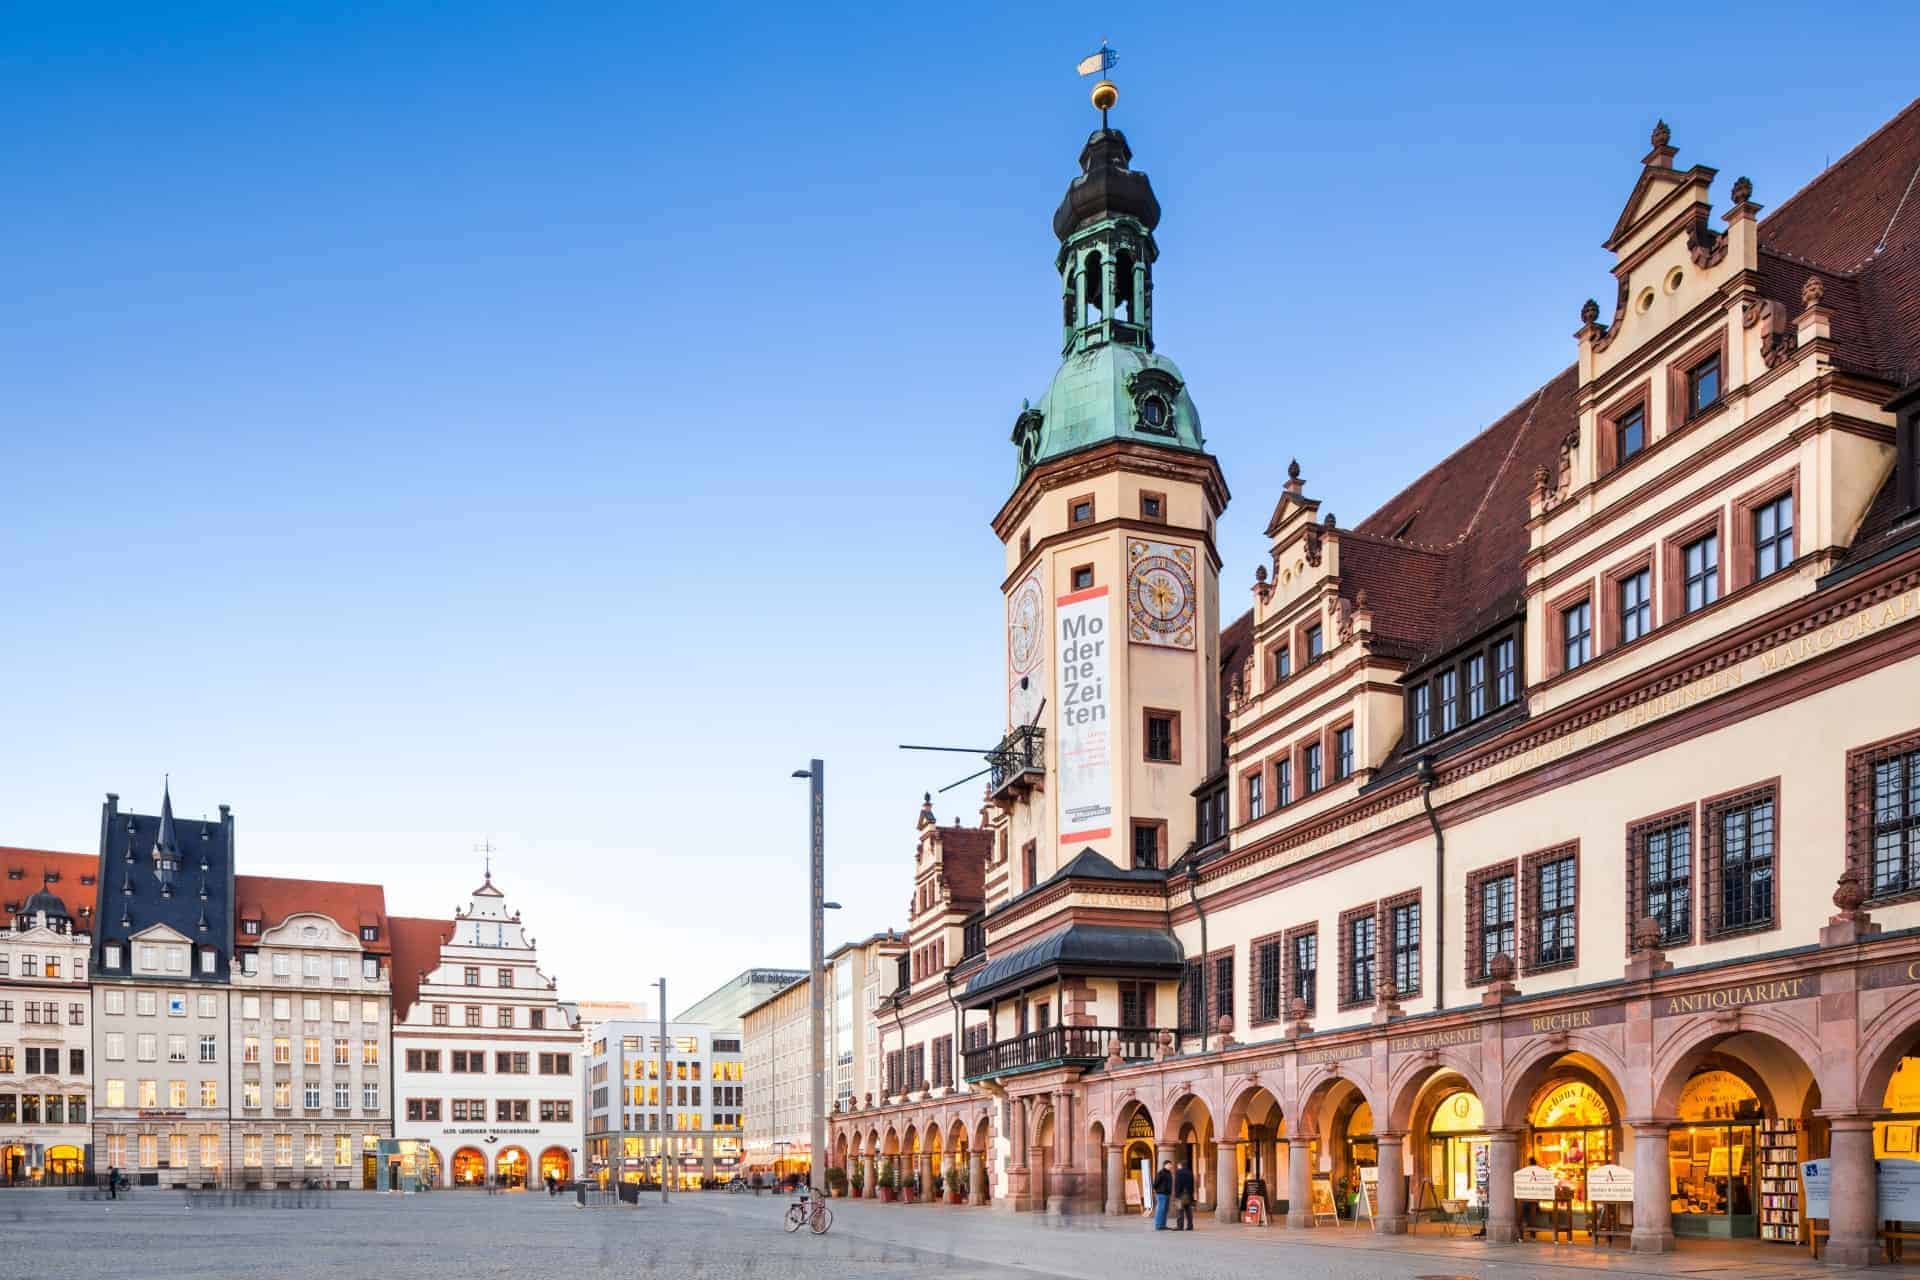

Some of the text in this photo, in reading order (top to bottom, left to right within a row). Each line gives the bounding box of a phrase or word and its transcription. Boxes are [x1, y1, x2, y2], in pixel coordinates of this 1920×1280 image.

[1062, 614, 1104, 641] Mo
[1063, 640, 1105, 663] der
[1063, 661, 1094, 682] ne
[1064, 677, 1102, 706] Zei
[1063, 703, 1106, 727] ten
[1667, 978, 1803, 1013] ANTIQUARIAT
